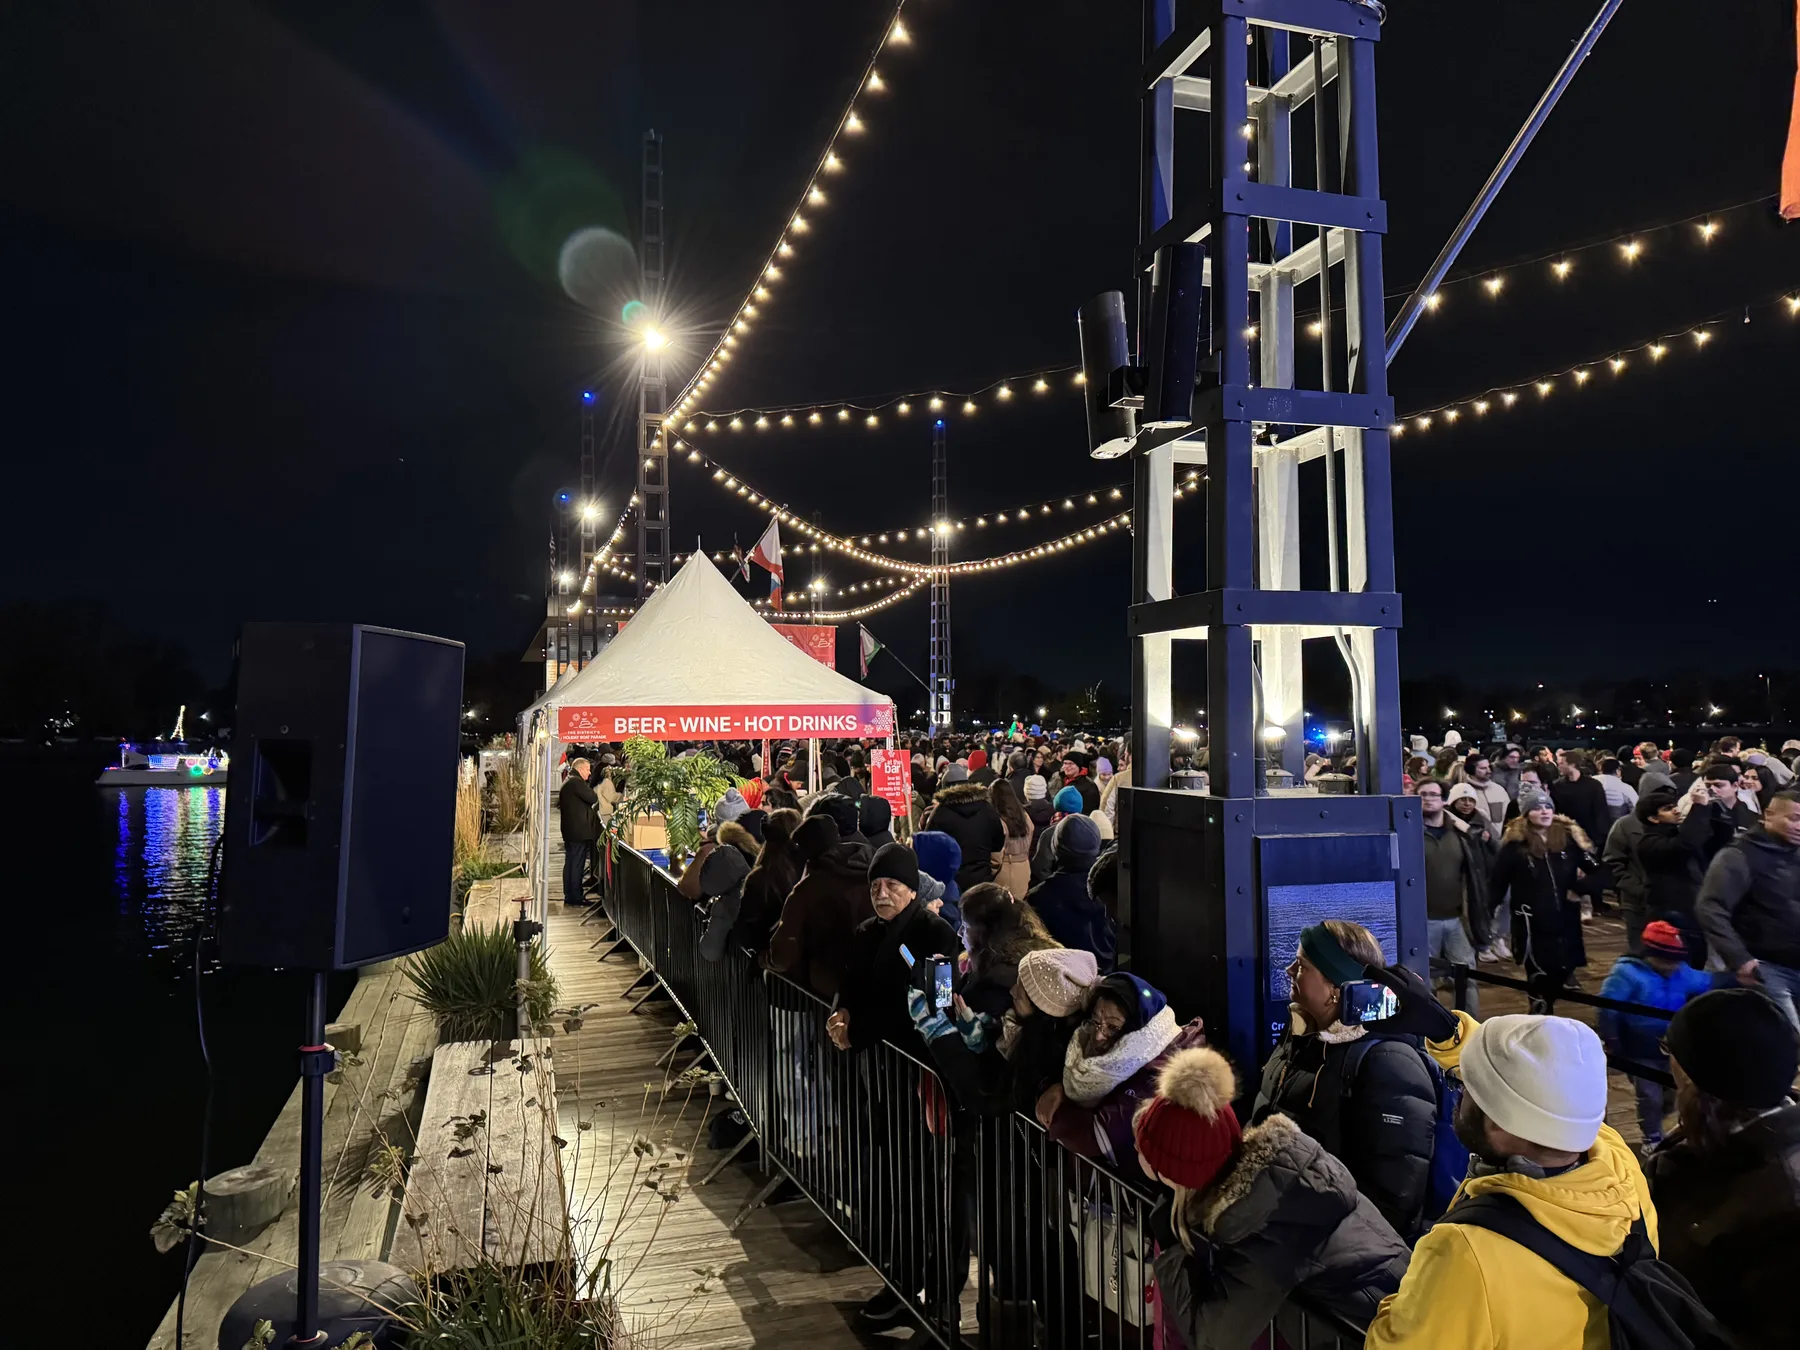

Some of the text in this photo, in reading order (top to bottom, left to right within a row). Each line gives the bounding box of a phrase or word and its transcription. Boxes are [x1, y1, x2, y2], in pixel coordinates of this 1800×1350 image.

[614, 717, 666, 734] BEER
[679, 716, 731, 733] WINE
[744, 715, 784, 732] HOT
[788, 714, 858, 731] DRINKS
[885, 762, 901, 773] bar
